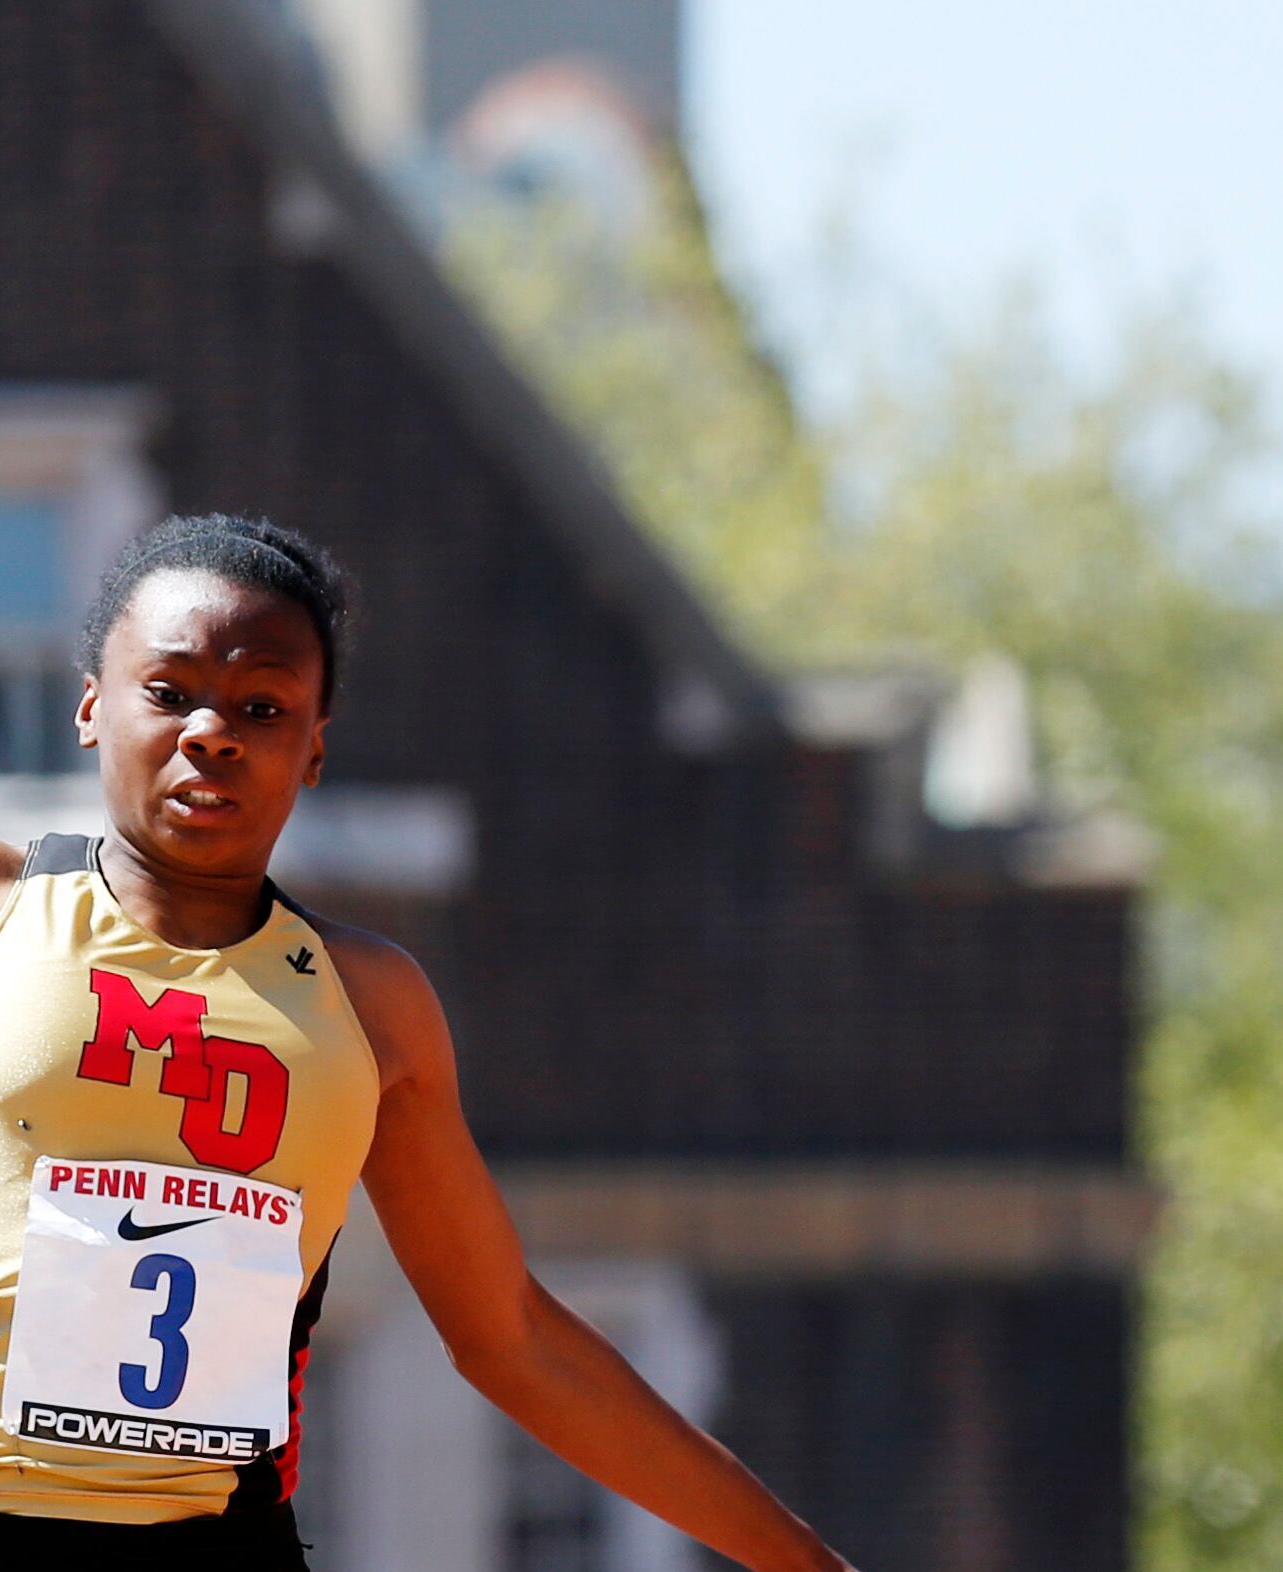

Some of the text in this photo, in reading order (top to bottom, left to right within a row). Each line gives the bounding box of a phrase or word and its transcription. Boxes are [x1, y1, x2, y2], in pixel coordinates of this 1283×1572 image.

[50, 1166, 288, 1225] PENN RELAYS
[119, 1253, 196, 1410] 3
